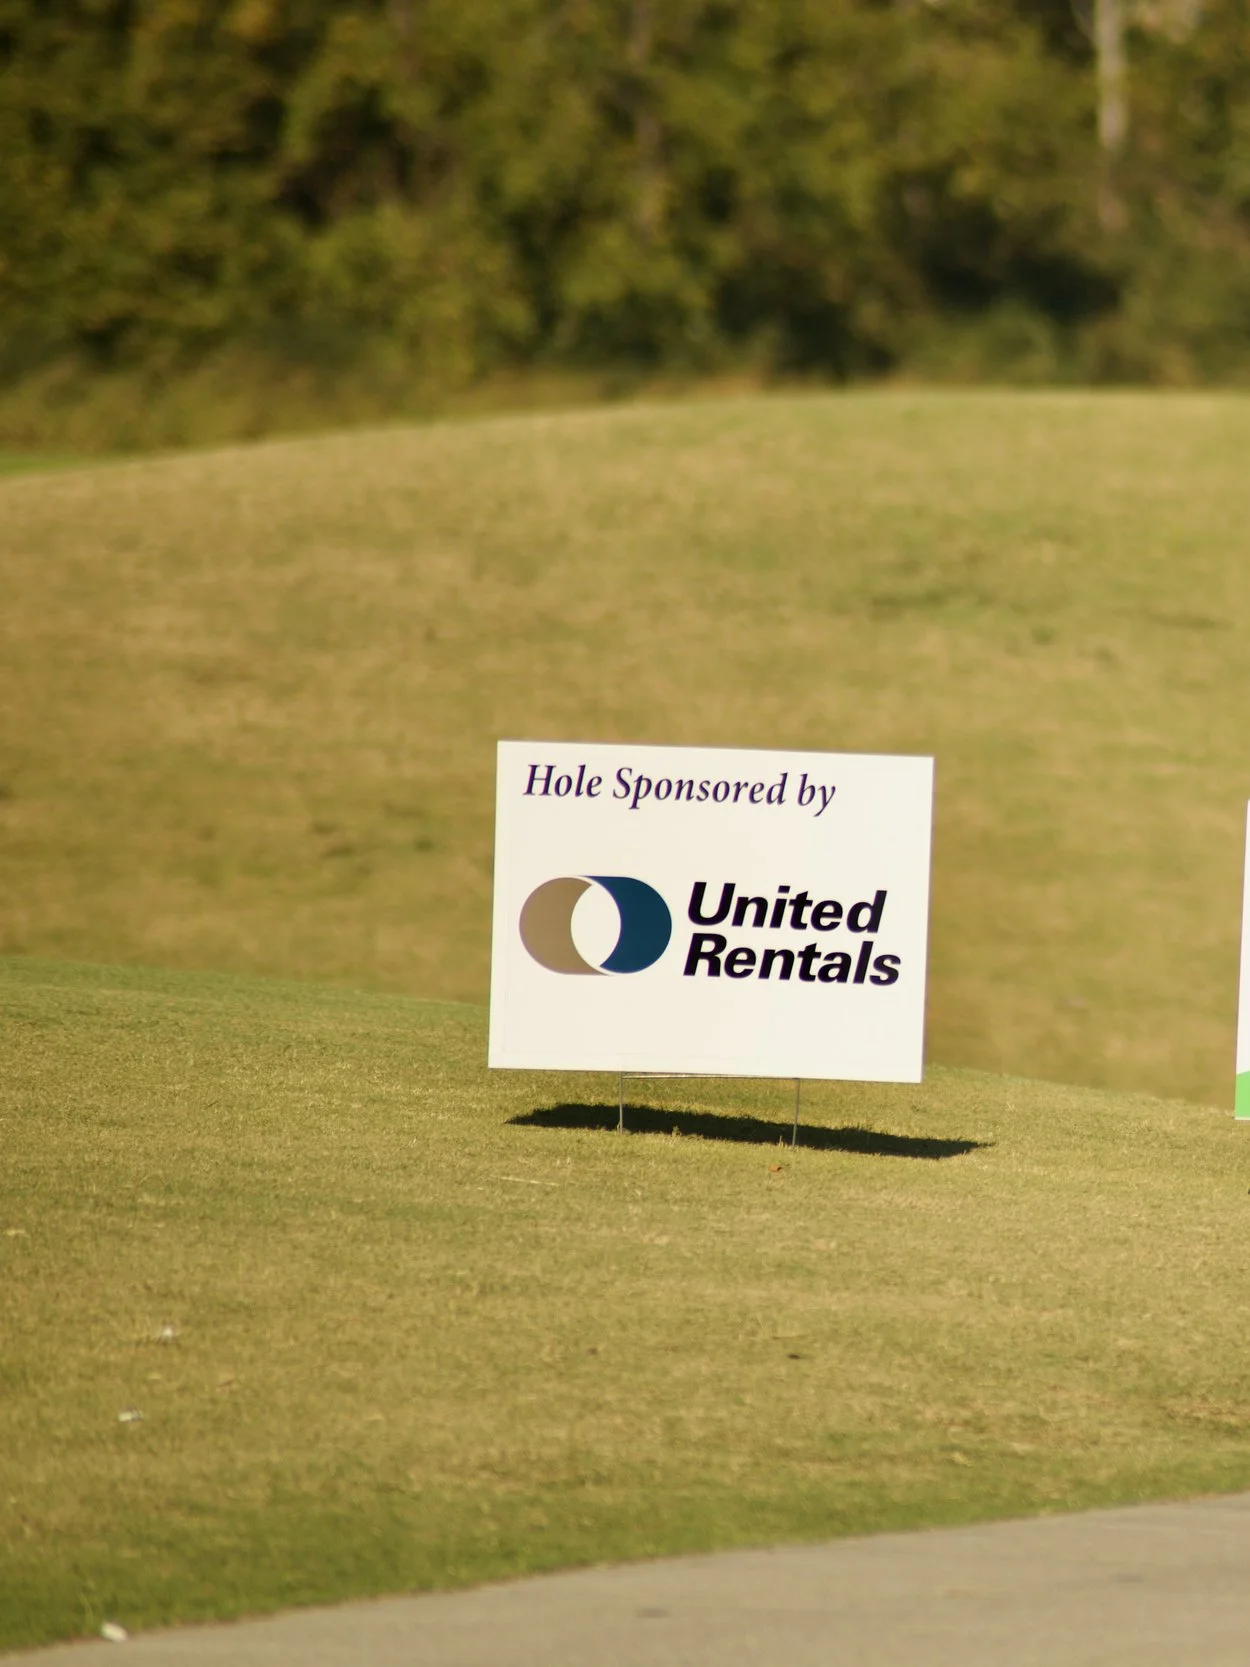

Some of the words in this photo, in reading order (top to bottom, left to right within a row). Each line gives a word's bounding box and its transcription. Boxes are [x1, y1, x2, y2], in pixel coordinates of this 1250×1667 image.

[523, 764, 602, 798] Hole
[613, 767, 789, 809] Sponsored
[797, 773, 836, 818] by
[687, 881, 888, 934] United
[683, 931, 901, 987] Rentals
